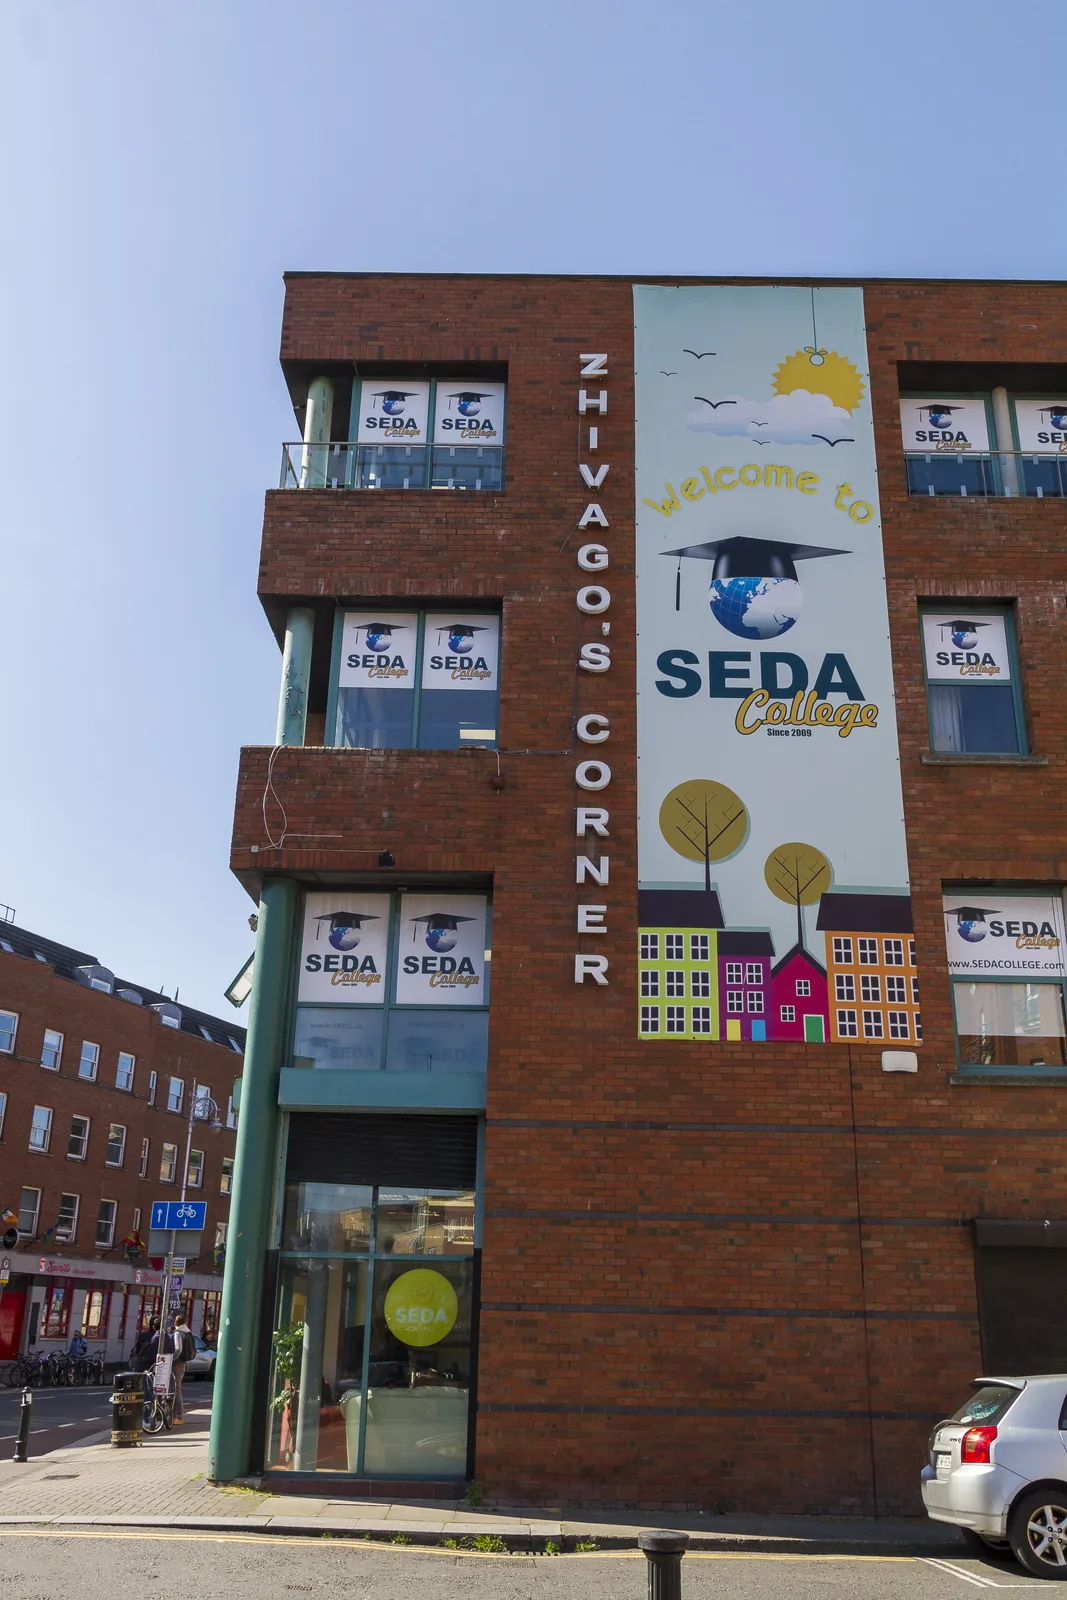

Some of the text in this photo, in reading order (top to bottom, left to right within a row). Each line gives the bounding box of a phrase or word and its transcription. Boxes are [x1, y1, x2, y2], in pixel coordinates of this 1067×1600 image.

[365, 417, 418, 429] SEDA
[441, 418, 494, 431] SEDA
[384, 426, 421, 438] College
[460, 427, 497, 439] College
[915, 430, 969, 443] SEDA
[1037, 432, 1067, 444] SE
[935, 439, 972, 451] College
[642, 464, 875, 524] Welcome to
[347, 654, 405, 669] SEDA
[430, 656, 489, 671] SEDA
[936, 652, 997, 667] SEDA
[367, 665, 409, 679] College
[451, 667, 492, 680] College
[575, 353, 612, 985] ZHIVAGO'S CORNER
[655, 649, 866, 701] SEDA
[959, 662, 1001, 677] College
[735, 688, 879, 738] College
[766, 728, 812, 738] Since 2009
[989, 921, 1056, 938] SEDA
[1015, 933, 1061, 950] College
[305, 953, 378, 974] SEDA
[403, 955, 476, 975] SEDA
[331, 968, 382, 987] College
[429, 970, 480, 988] College
[169, 1300, 181, 1310] YES
[395, 1307, 448, 1324] SEDA
